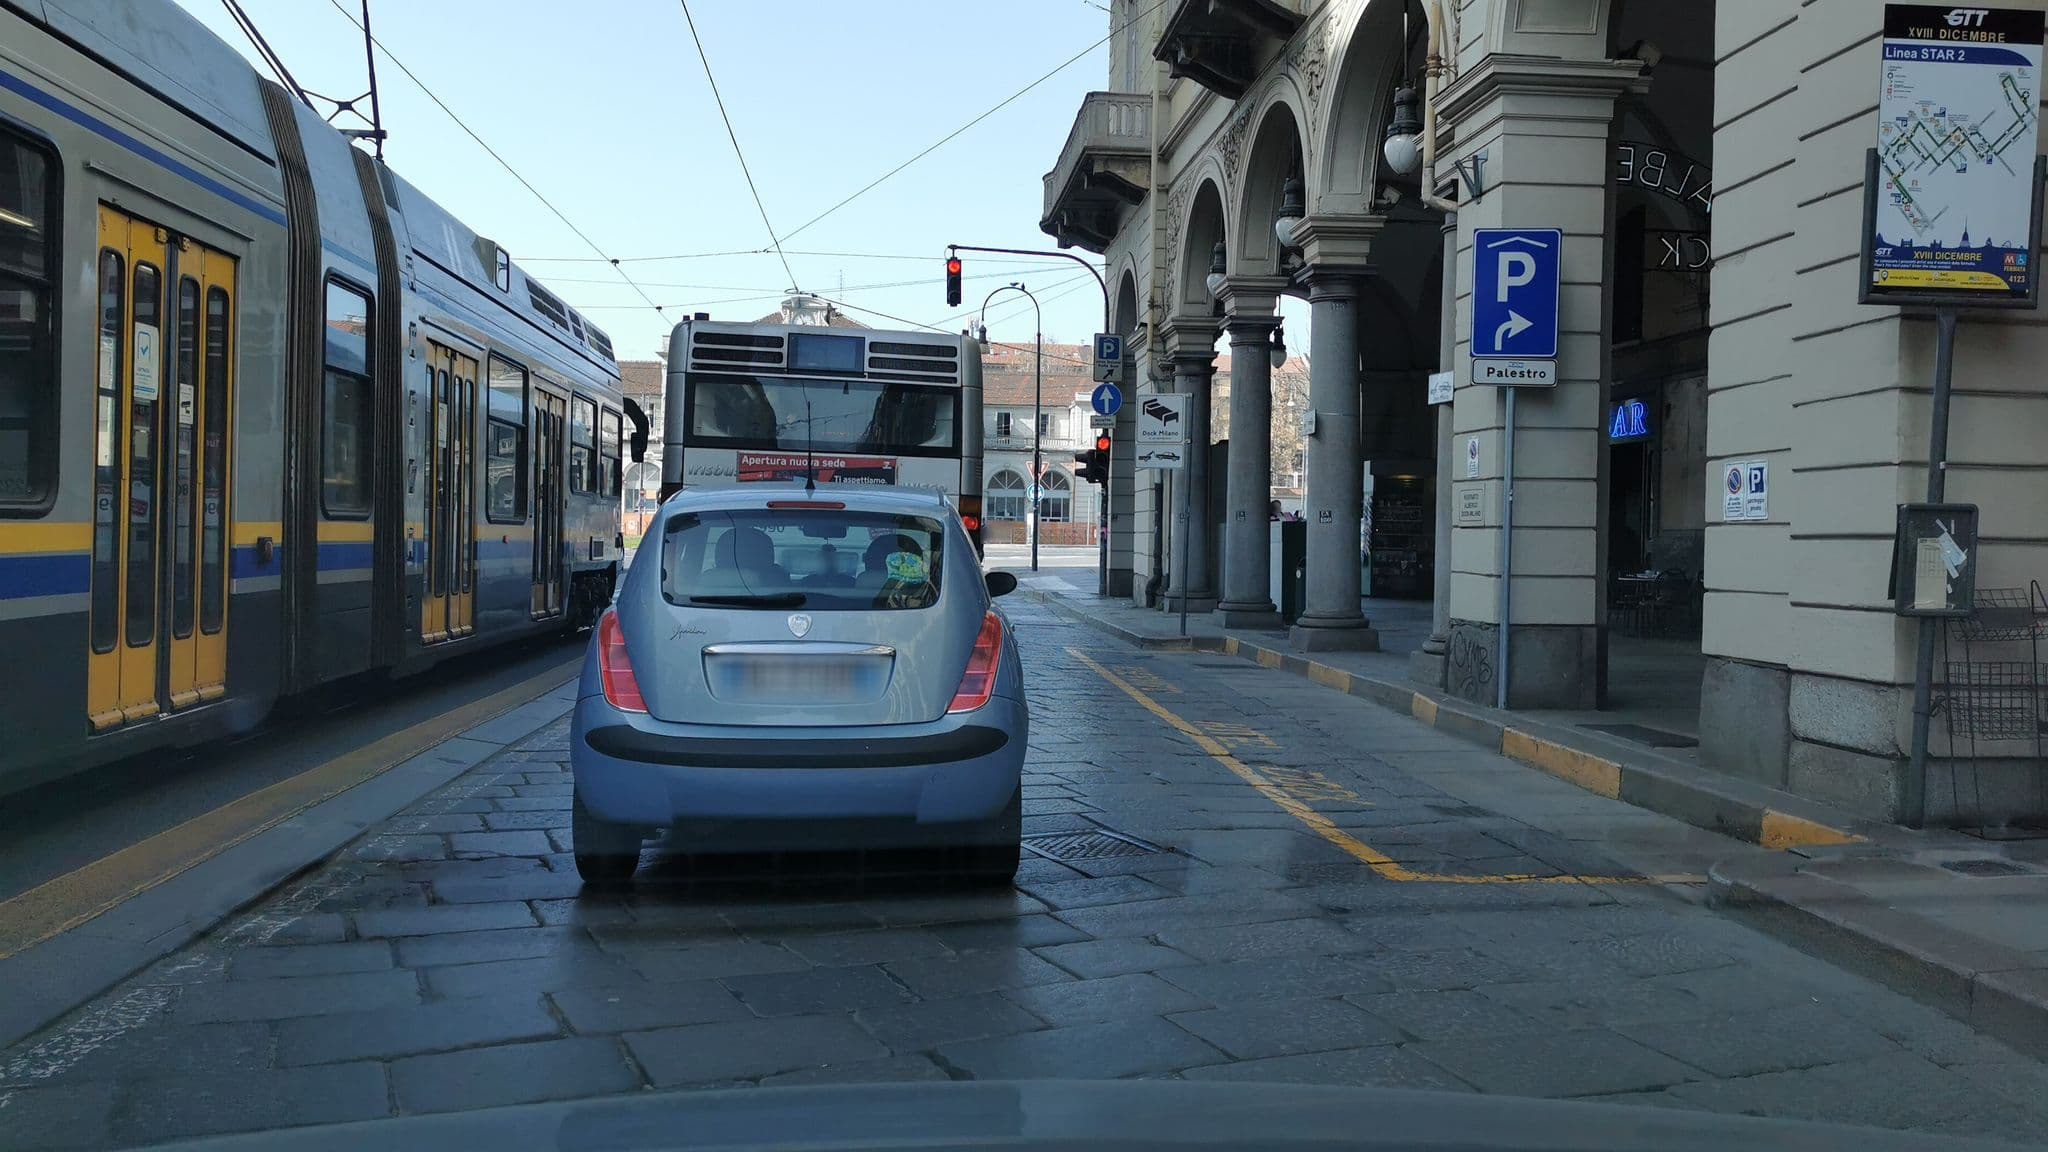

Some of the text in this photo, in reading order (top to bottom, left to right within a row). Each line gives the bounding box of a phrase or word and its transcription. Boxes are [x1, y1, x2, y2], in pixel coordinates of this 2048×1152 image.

[1944, 9, 1989, 26] GTT
[1908, 27, 2006, 43] XVIII DICEMBRE
[1885, 47, 1966, 61] Linea STAR 2
[1913, 251, 1982, 262] XVIII DICEMBRE
[1497, 251, 1537, 303] P
[2008, 275, 2026, 284] 4123
[1103, 342, 1115, 358] P
[1487, 366, 1547, 379] Palestro
[1609, 402, 1646, 437] AR
[742, 455, 787, 466] Apertura
[822, 459, 846, 468] sede
[834, 475, 841, 483] Ti
[1751, 469, 1761, 491] P
